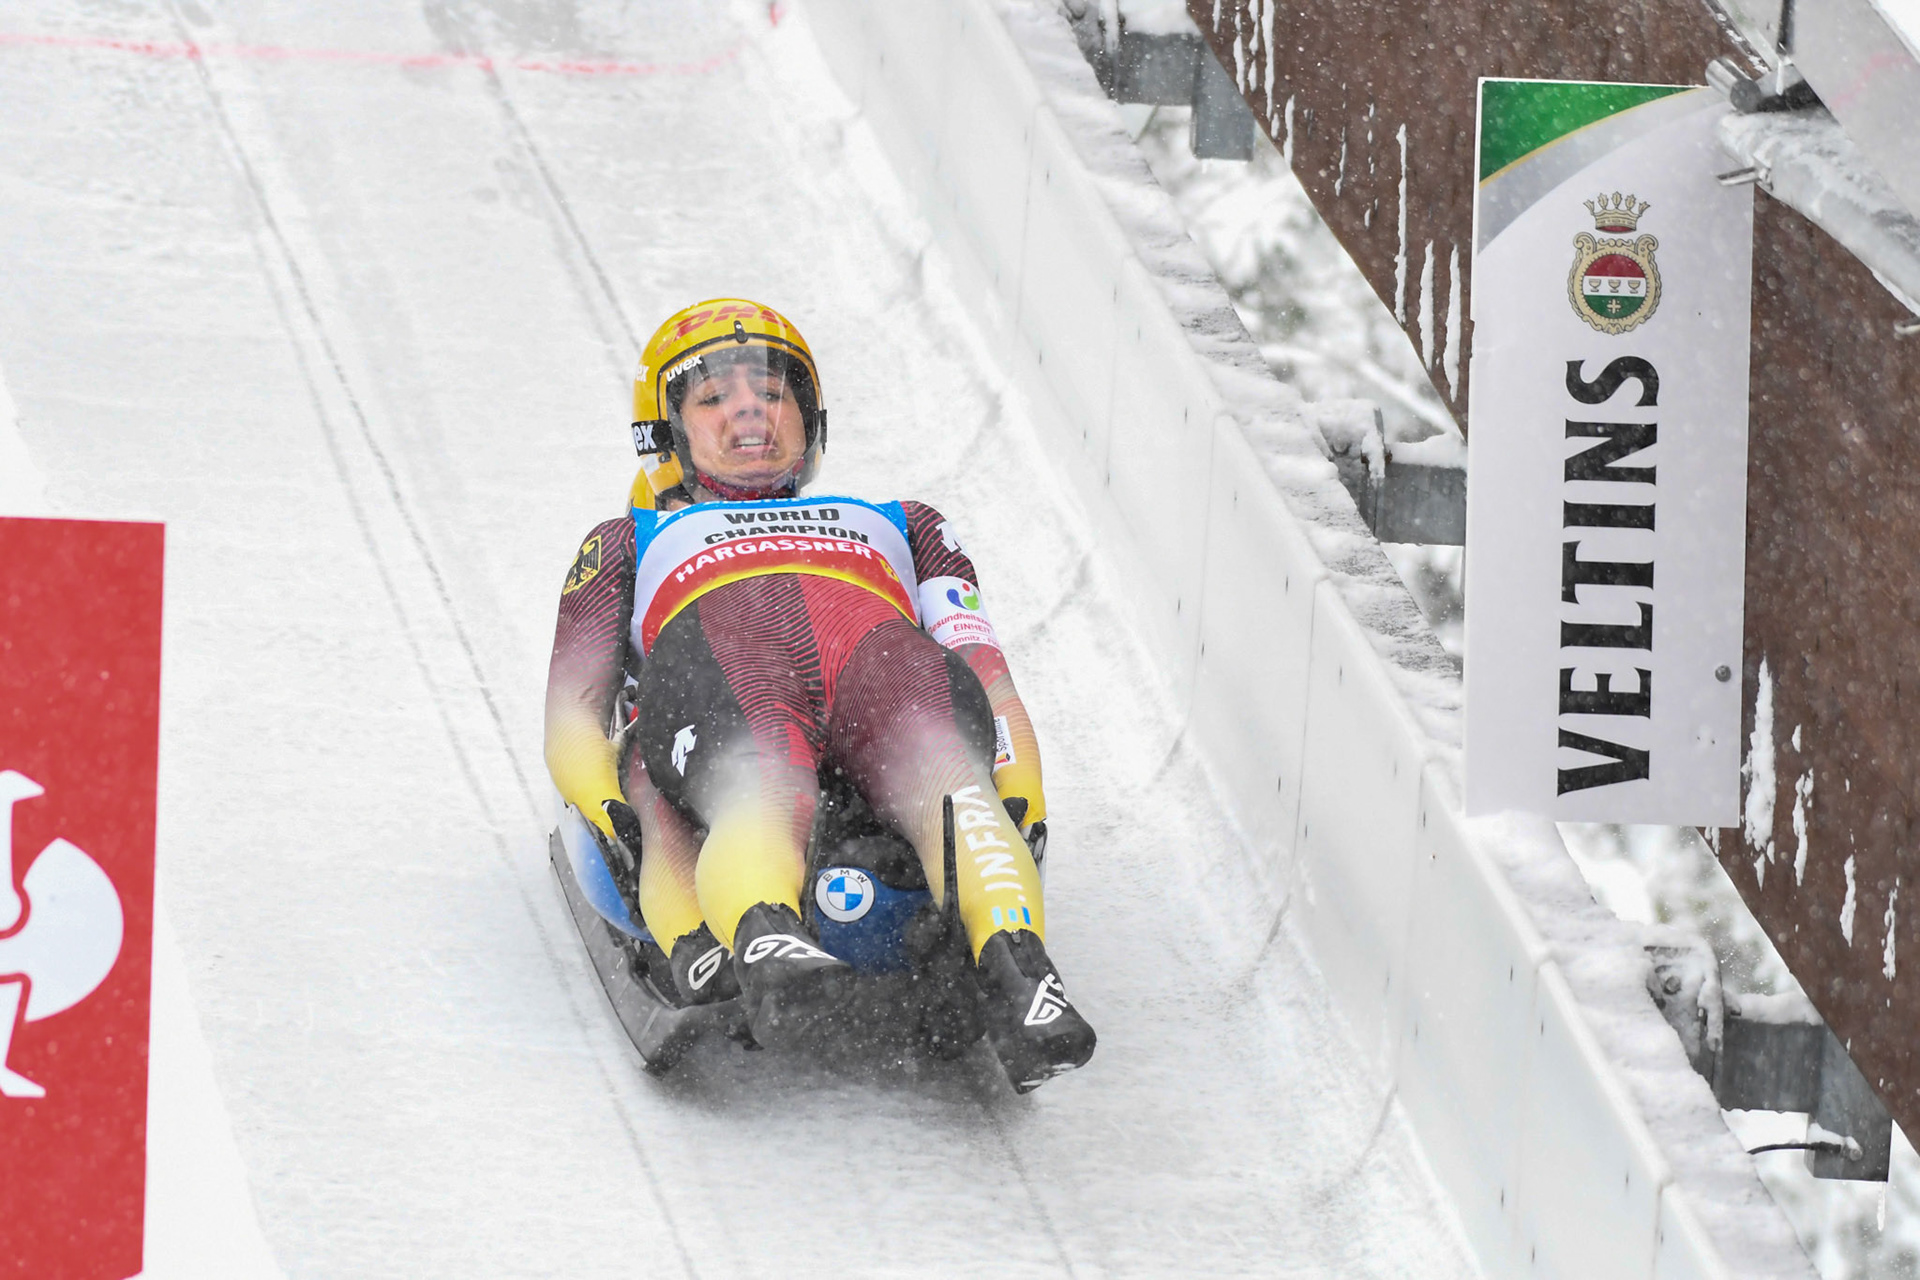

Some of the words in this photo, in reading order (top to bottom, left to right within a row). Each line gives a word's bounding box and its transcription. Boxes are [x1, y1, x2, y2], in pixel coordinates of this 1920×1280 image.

[672, 305, 788, 342] DHL
[636, 364, 650, 382] ex
[666, 354, 703, 382] uvex
[633, 424, 657, 451] ex
[724, 508, 839, 525] WORLD
[704, 525, 869, 545] CHAMPION
[675, 539, 873, 583] HARGASSNER
[1557, 355, 1659, 797] VELTINS
[953, 623, 991, 635] EINHEIT
[945, 635, 981, 648] hemnitz
[823, 869, 867, 883] BMW
